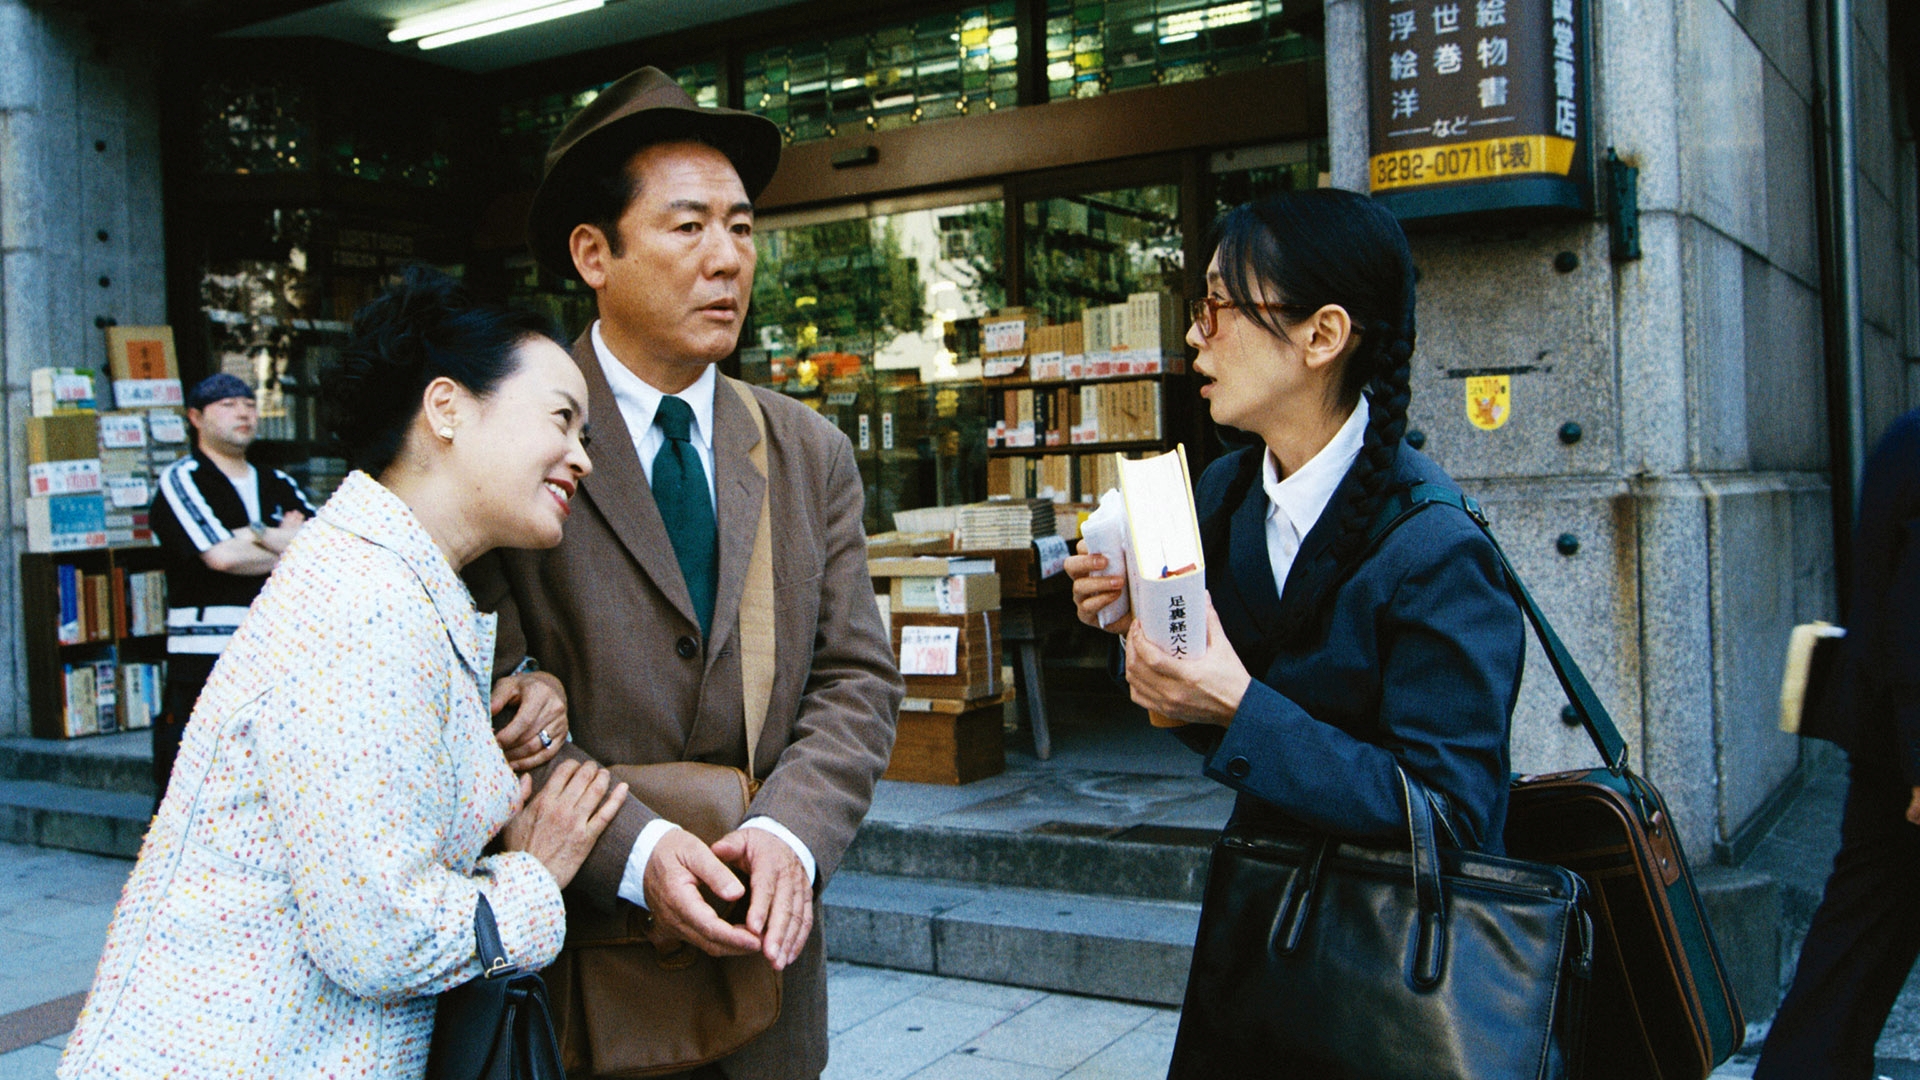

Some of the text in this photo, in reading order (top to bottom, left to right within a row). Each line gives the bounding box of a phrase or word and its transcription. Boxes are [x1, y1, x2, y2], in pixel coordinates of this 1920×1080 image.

[1388, 0, 1507, 42] 浮世絵
[1389, 37, 1509, 82] 絵巻物
[1431, 116, 1468, 138] など
[1169, 595, 1187, 659] 足裏経穴大
